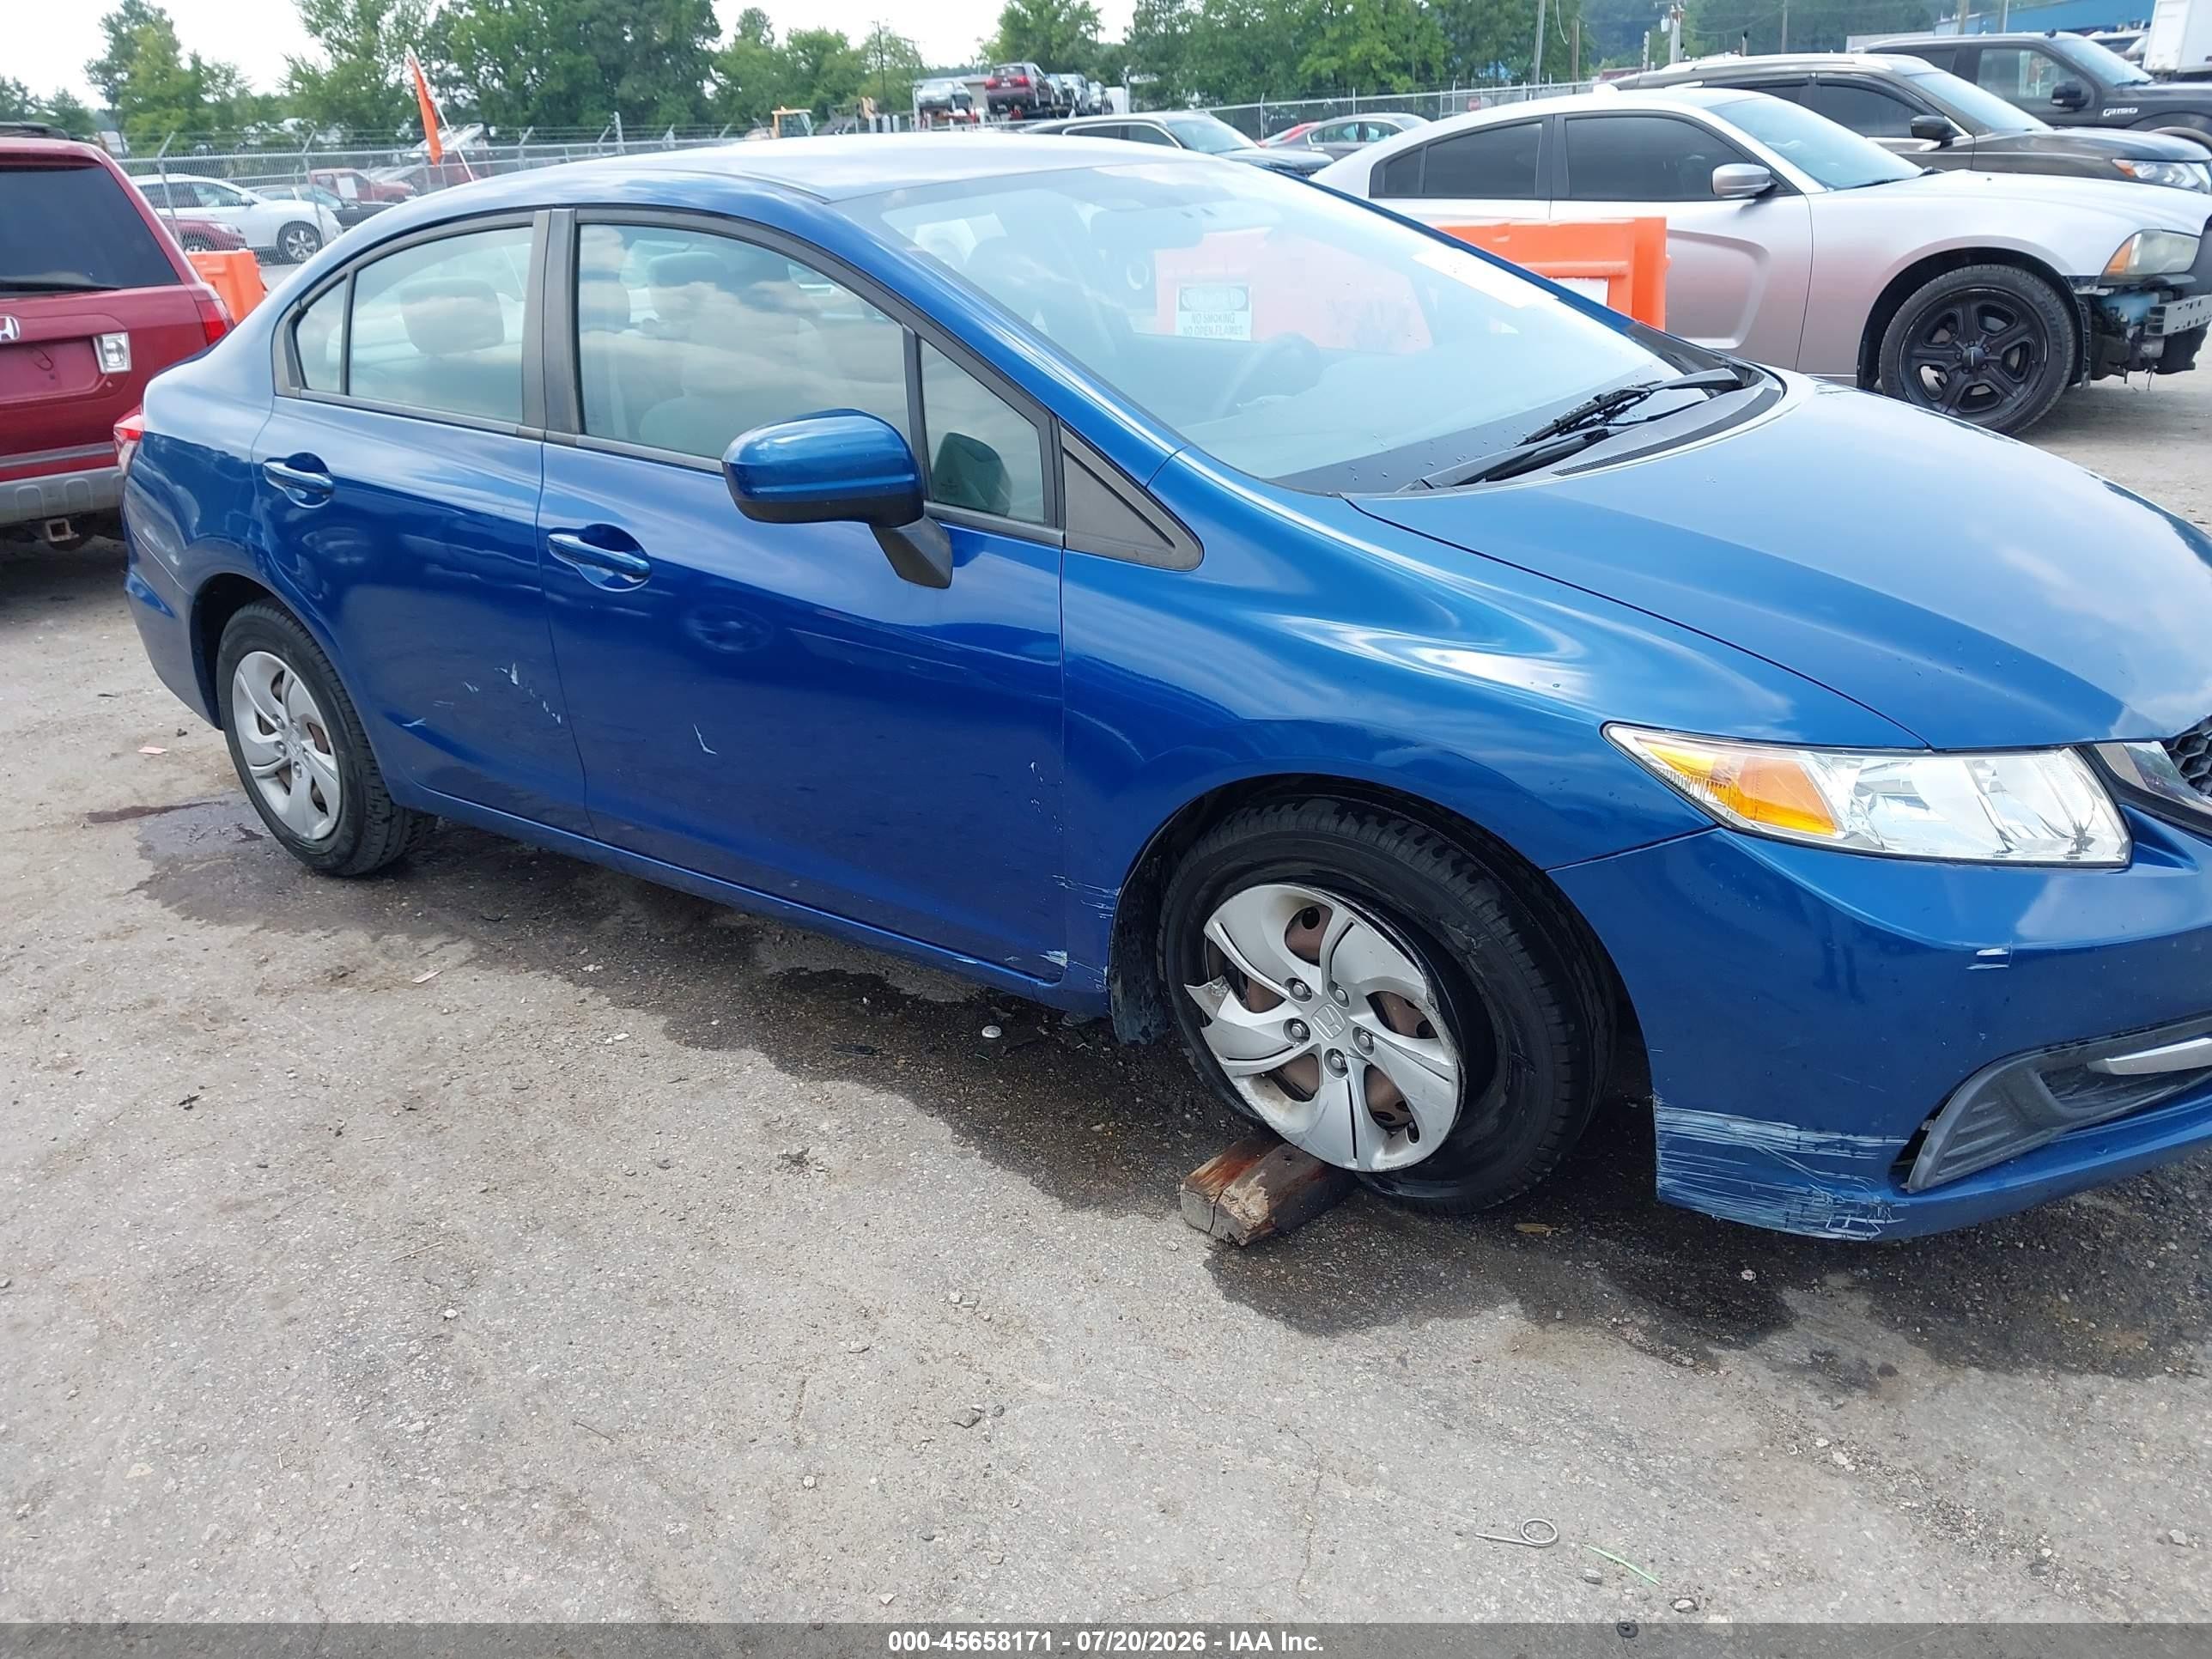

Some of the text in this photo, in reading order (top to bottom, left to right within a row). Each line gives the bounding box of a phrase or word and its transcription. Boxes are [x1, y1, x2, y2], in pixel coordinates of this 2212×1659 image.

[1191, 312, 1236, 325] NO SMOKING
[1182, 325, 1243, 337] NO OPEN FLAMES
